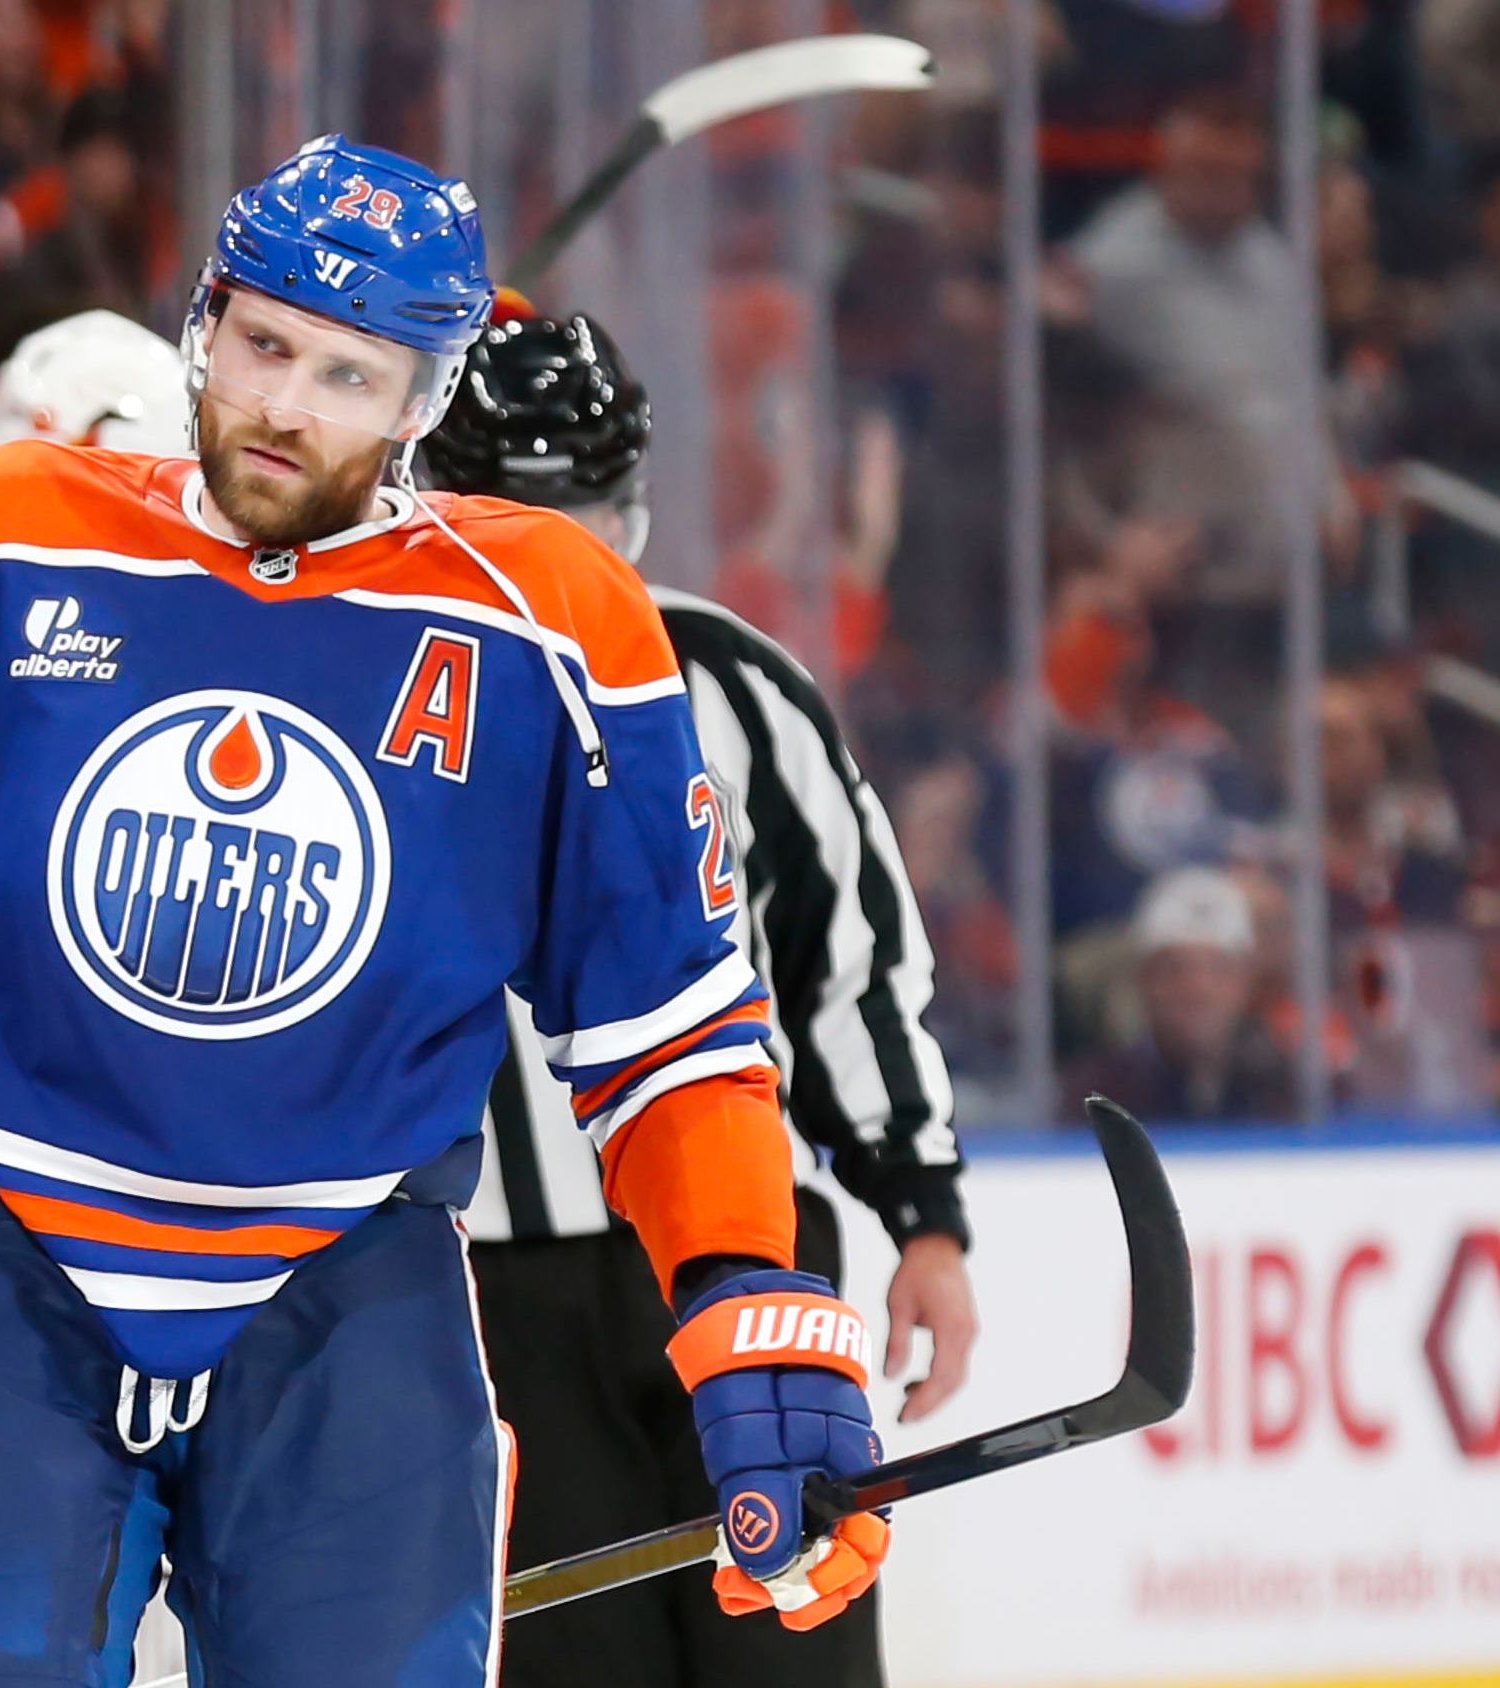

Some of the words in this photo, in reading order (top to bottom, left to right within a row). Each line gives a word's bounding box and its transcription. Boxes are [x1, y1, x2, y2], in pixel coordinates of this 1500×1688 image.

[332, 180, 403, 230] 29
[9, 653, 118, 680] alberta
[48, 629, 122, 659] play
[377, 627, 481, 784] A
[94, 808, 341, 1006] OILERS
[1132, 1244, 1388, 1458] IBC
